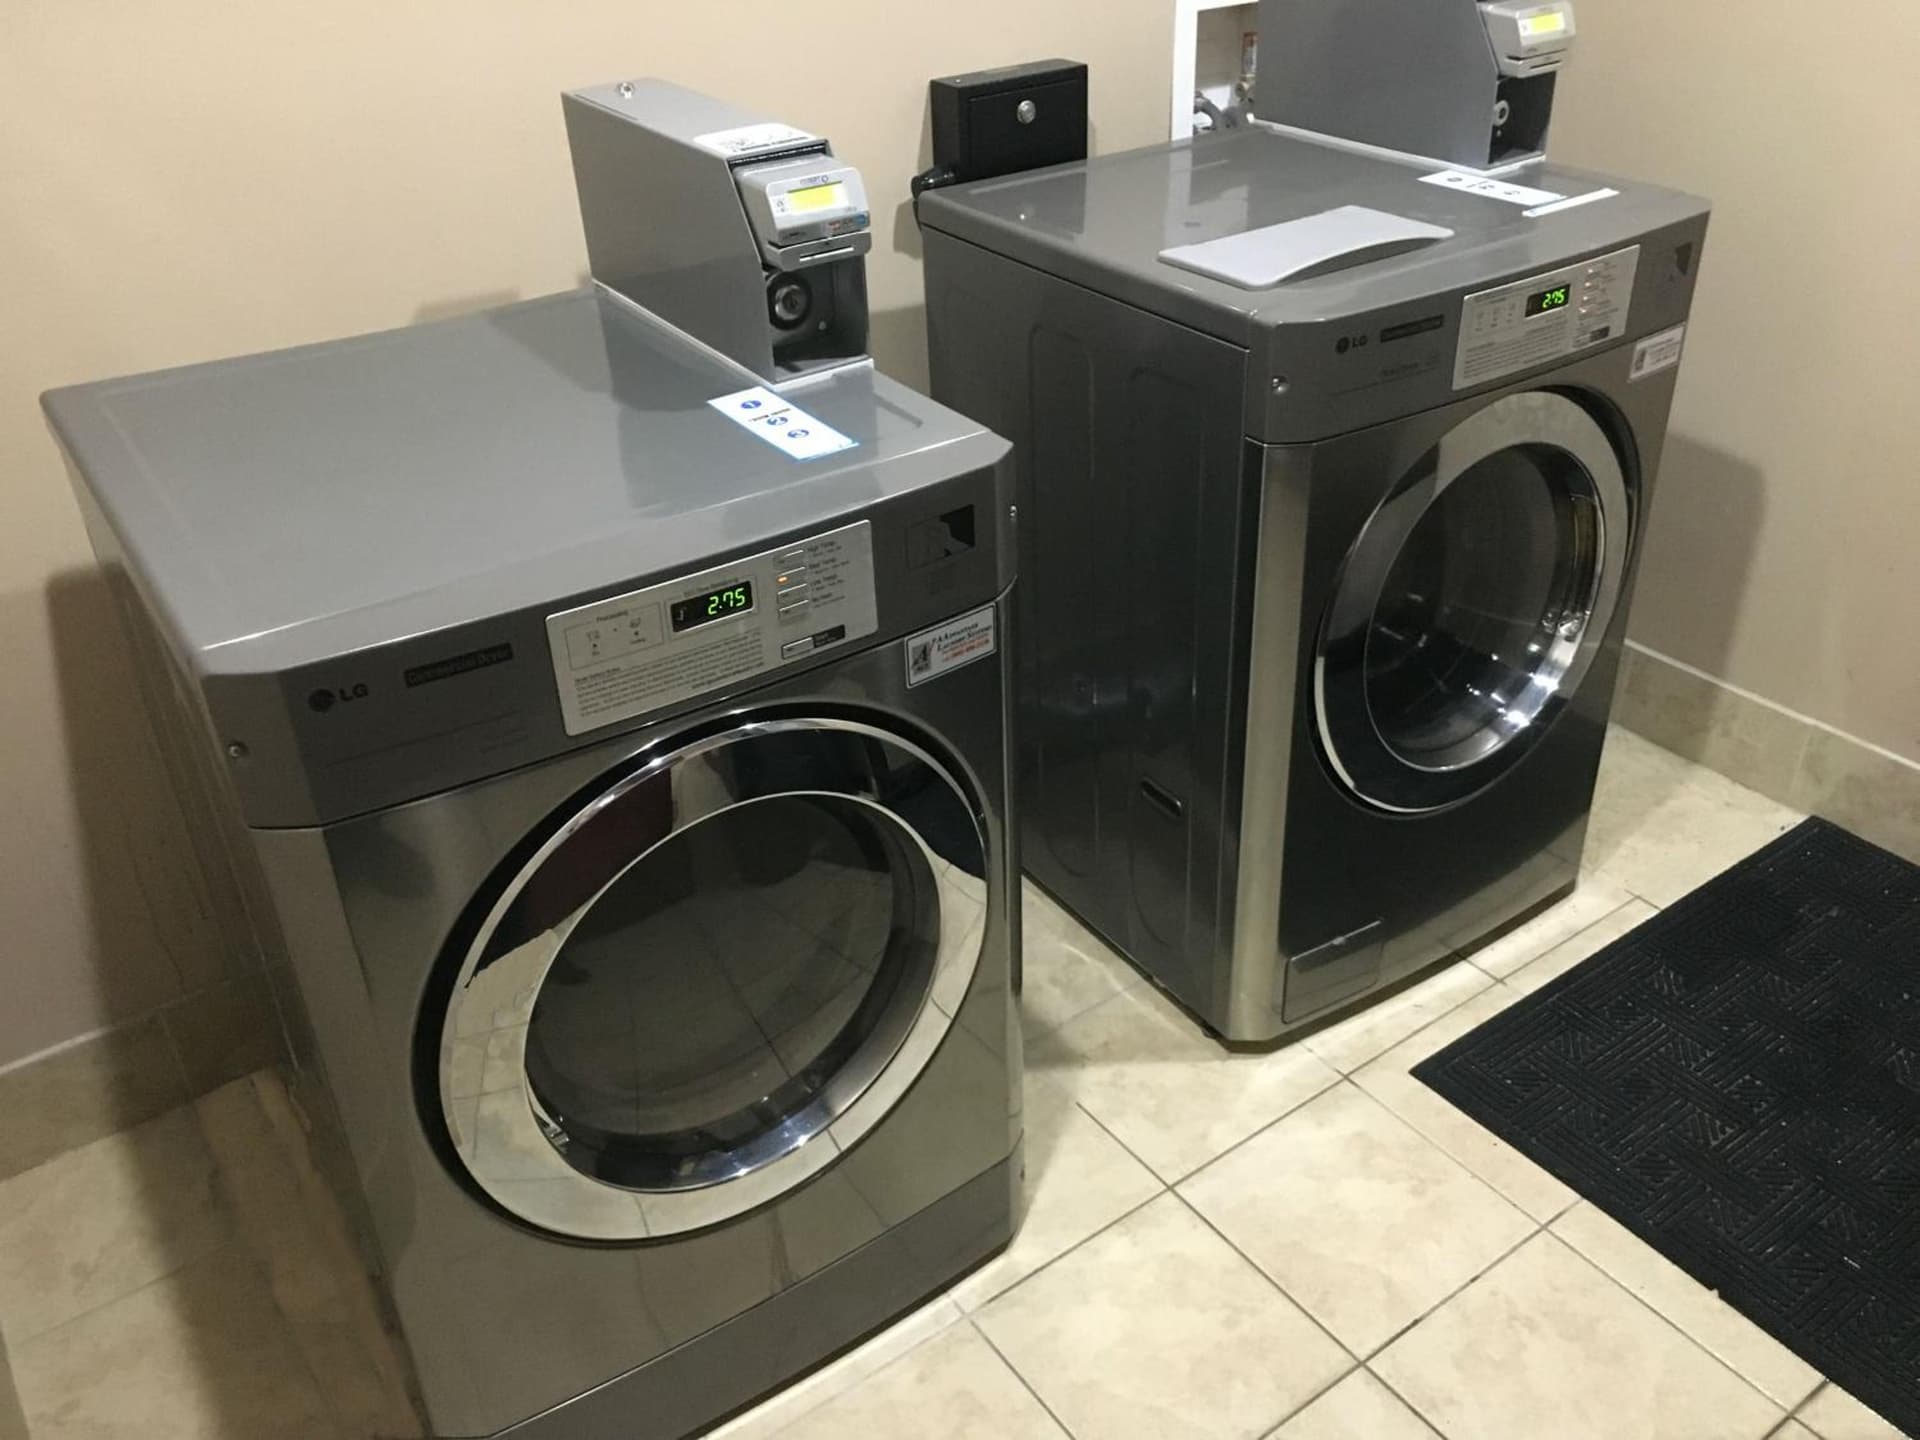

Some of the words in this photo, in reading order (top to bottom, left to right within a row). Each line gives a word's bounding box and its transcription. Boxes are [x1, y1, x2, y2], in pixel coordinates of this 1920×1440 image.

[1542, 289, 1565, 308] 2.75
[1352, 335, 1368, 348] LG
[708, 588, 745, 615] 2.75
[339, 683, 369, 701] LG
